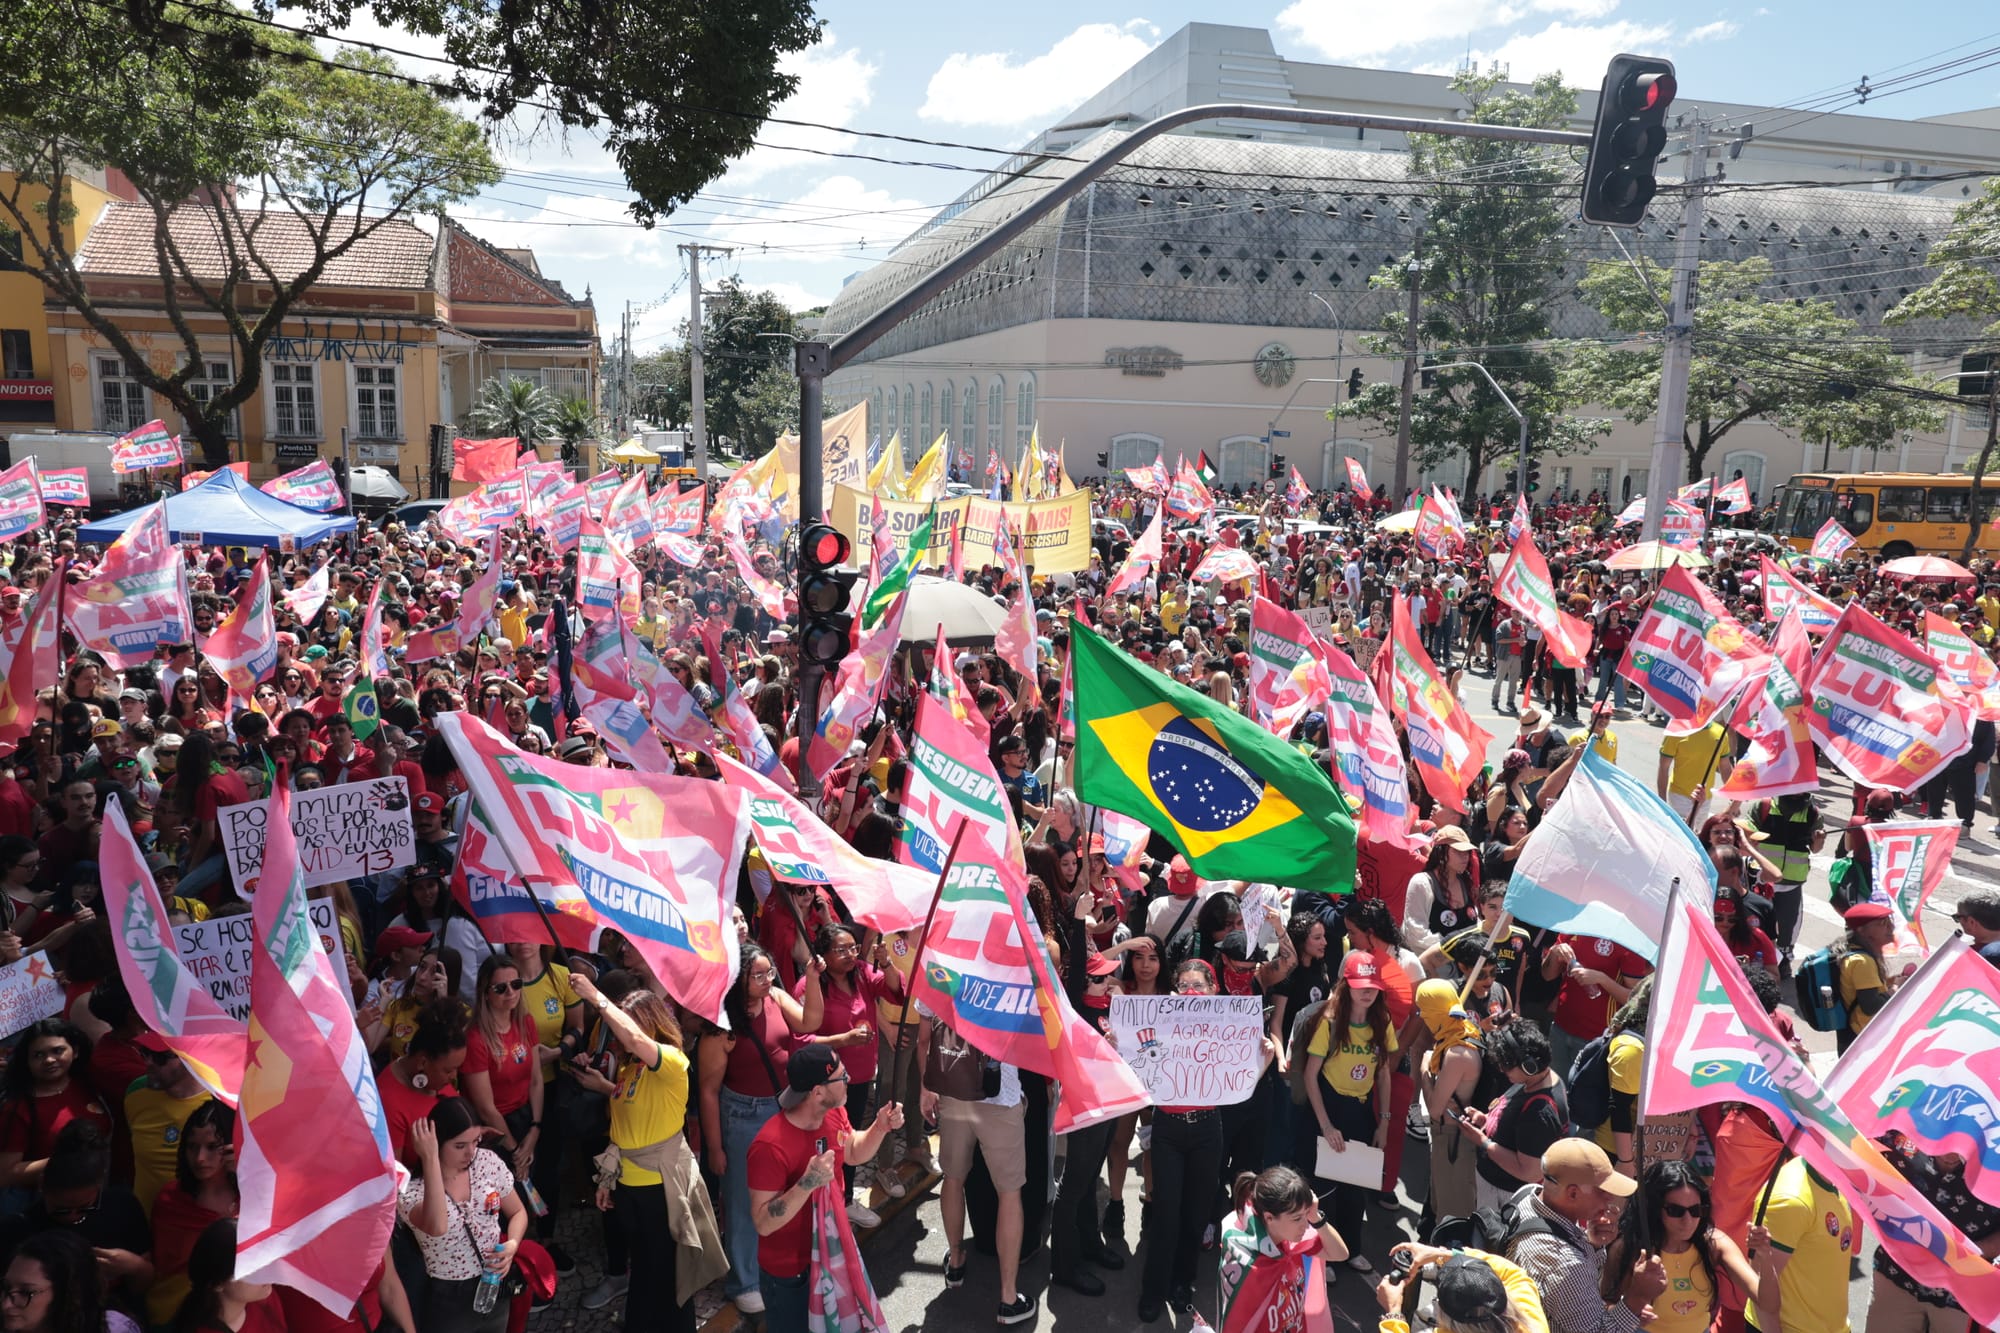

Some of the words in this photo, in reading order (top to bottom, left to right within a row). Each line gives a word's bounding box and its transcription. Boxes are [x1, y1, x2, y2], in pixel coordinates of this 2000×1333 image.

[1840, 633, 1935, 683] PRESIDENTE
[1831, 703, 1853, 726] VICE
[1847, 712, 1913, 751] ALCKMIN
[1160, 732, 1196, 748] ORDEM
[1201, 745, 1208, 753] E
[1213, 751, 1261, 796] PROGRESSO
[342, 809, 377, 829] POR
[304, 833, 326, 850] AS
[345, 842, 367, 855] EU
[369, 835, 409, 850] VOTO
[914, 826, 938, 859] VICE
[356, 849, 394, 877] 13
[590, 875, 685, 933] ALCKMIN
[962, 979, 998, 1012] VICE
[1121, 999, 1158, 1027] MITO
[1188, 998, 1212, 1013] COM
[1214, 999, 1225, 1013] OS
[1229, 998, 1260, 1016] RATOS
[1171, 1023, 1222, 1041] AGORA
[1222, 1024, 1260, 1041] QUEM
[1193, 1040, 1252, 1065] GROSSO
[1161, 1058, 1223, 1101] SOMOS
[1922, 1088, 1979, 1121] VICE
